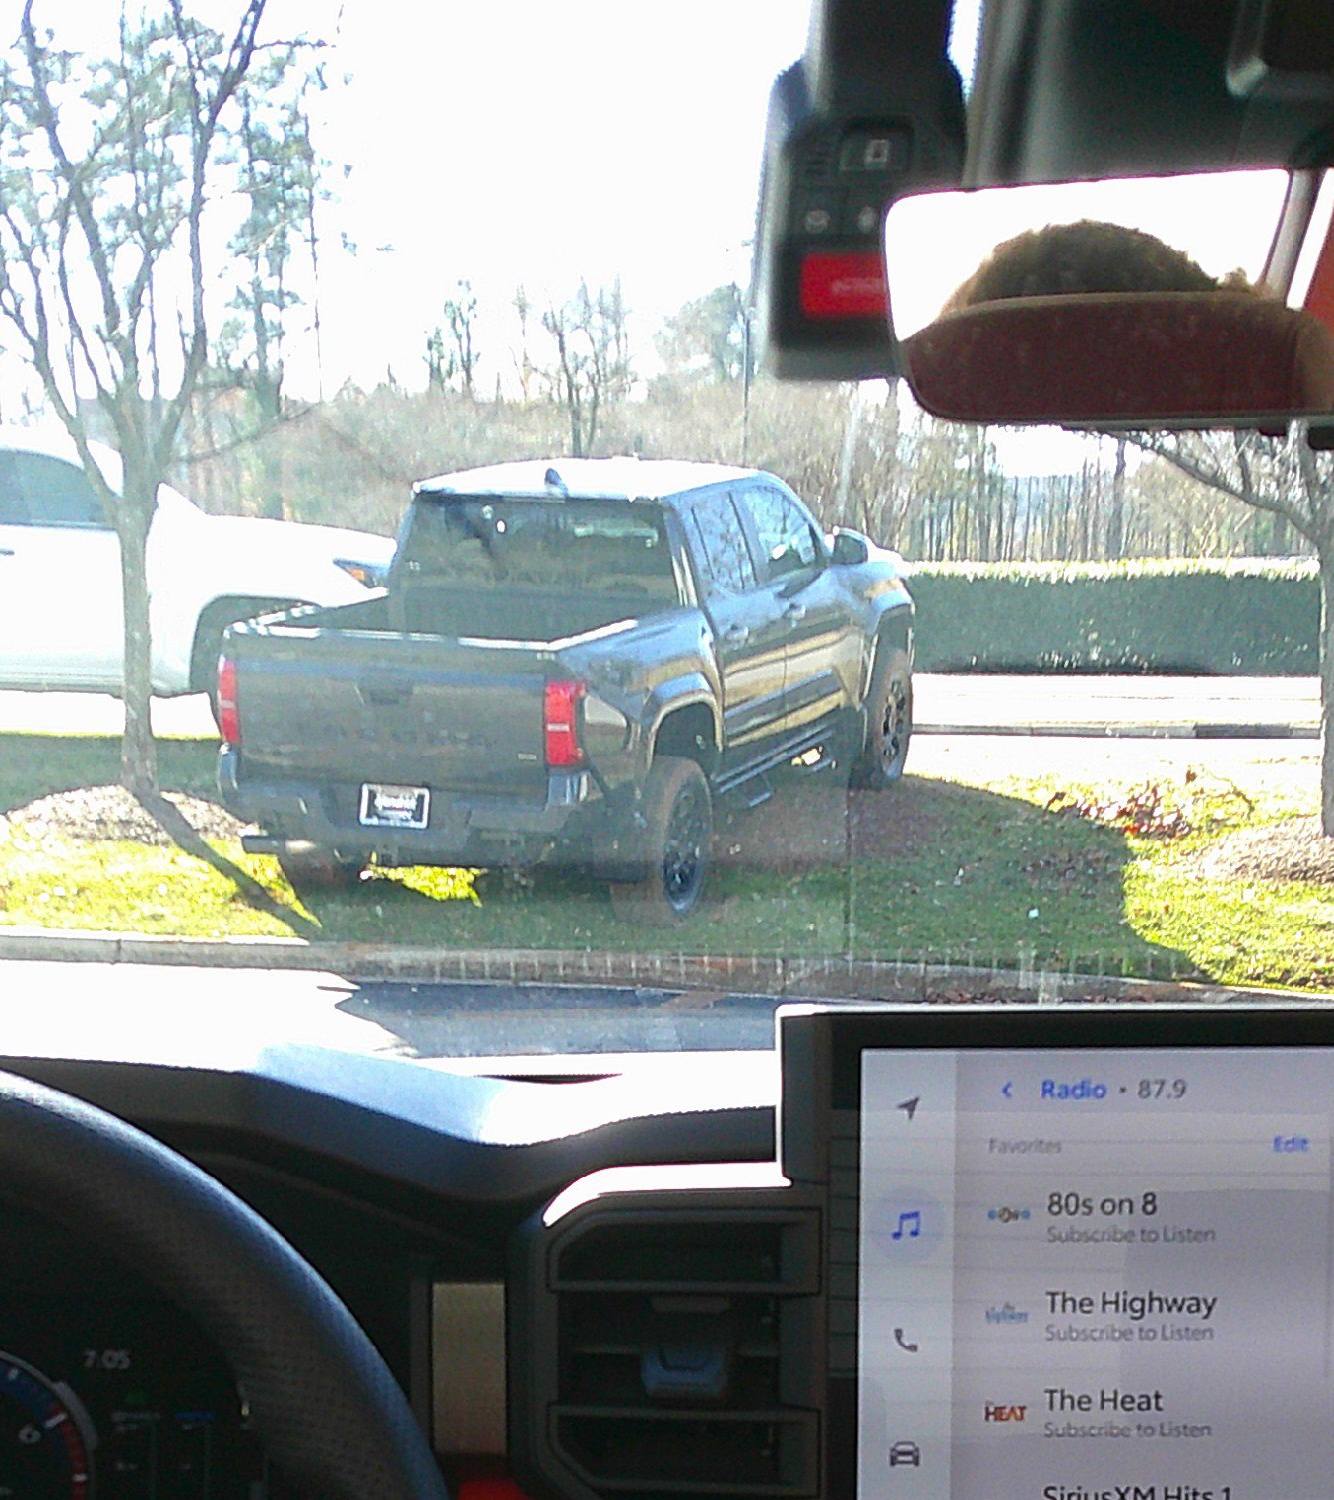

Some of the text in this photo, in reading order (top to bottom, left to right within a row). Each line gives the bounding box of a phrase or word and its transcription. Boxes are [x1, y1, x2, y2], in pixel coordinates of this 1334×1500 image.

[1040, 1079, 1188, 1100] Radio 87.9
[988, 1137, 1062, 1155] Favorites
[1272, 1135, 1310, 1154] Edit
[1047, 1192, 1094, 1217] 80s
[1100, 1197, 1134, 1217] on
[1142, 1192, 1159, 1217] 8
[1047, 1225, 1216, 1245] Subscribe to Listen
[1045, 1290, 1094, 1316] The
[1101, 1290, 1217, 1320] Highway
[1045, 1323, 1215, 1343] Subscribe to Listen
[1043, 1388, 1164, 1412] The Heat
[984, 1405, 1027, 1423] HEAT
[1043, 1420, 1212, 1439] Subscribe to Listen
